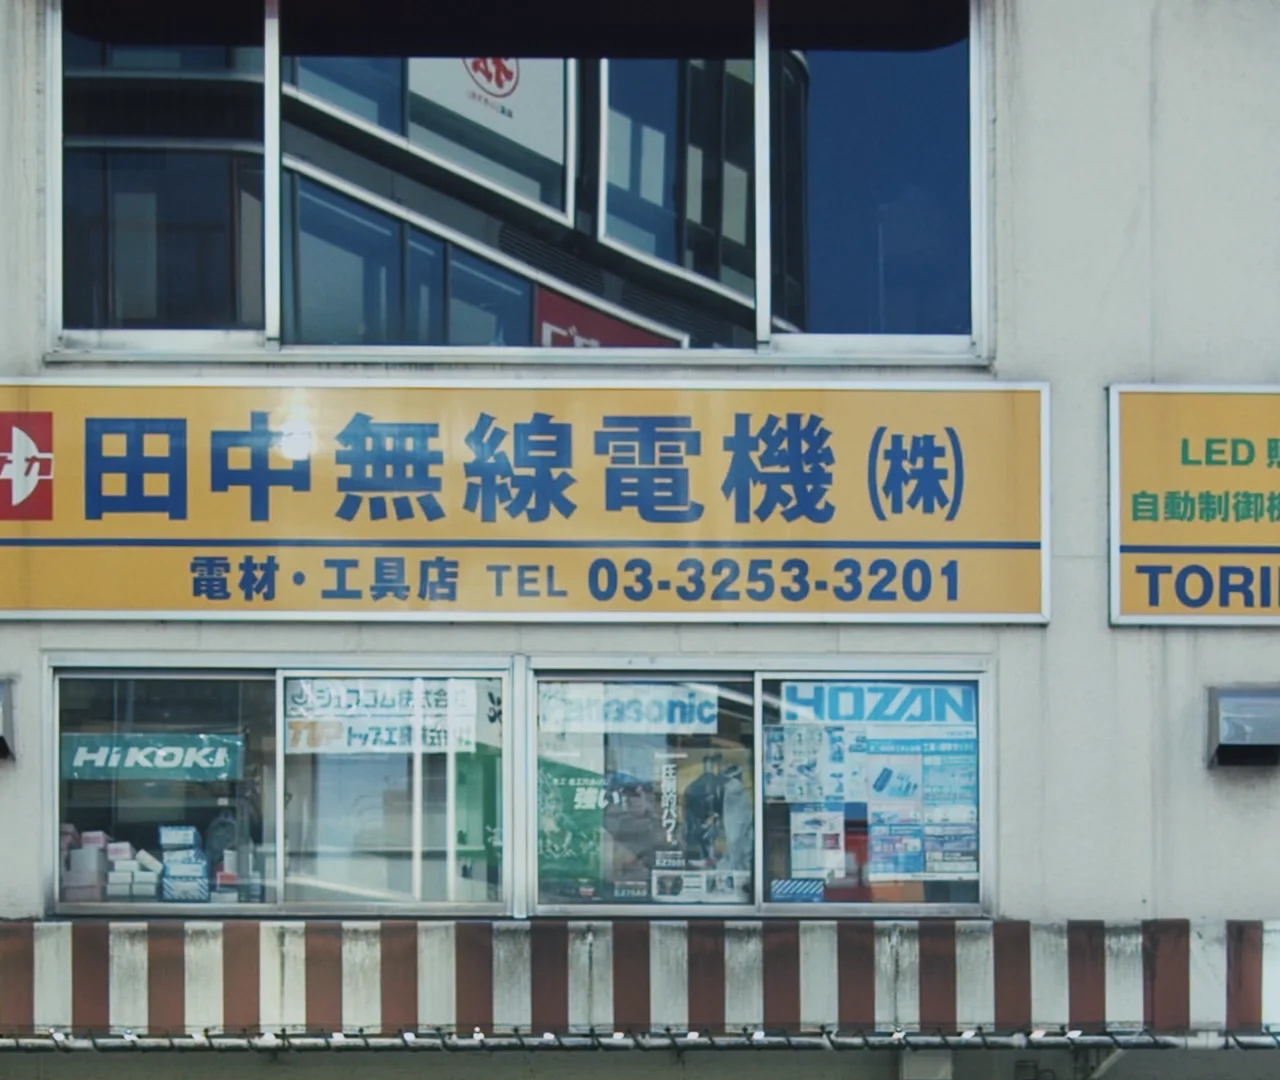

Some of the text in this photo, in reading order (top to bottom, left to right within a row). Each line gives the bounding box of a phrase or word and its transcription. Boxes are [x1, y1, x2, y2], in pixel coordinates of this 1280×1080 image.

[86, 412, 965, 524] 田中無線電機(株)
[1181, 438, 1256, 467] LED
[190, 556, 960, 603] 電材・工具店 TEL 03-3253-3201
[786, 686, 973, 722] HOZAN
[73, 747, 228, 768] HiKOKI
